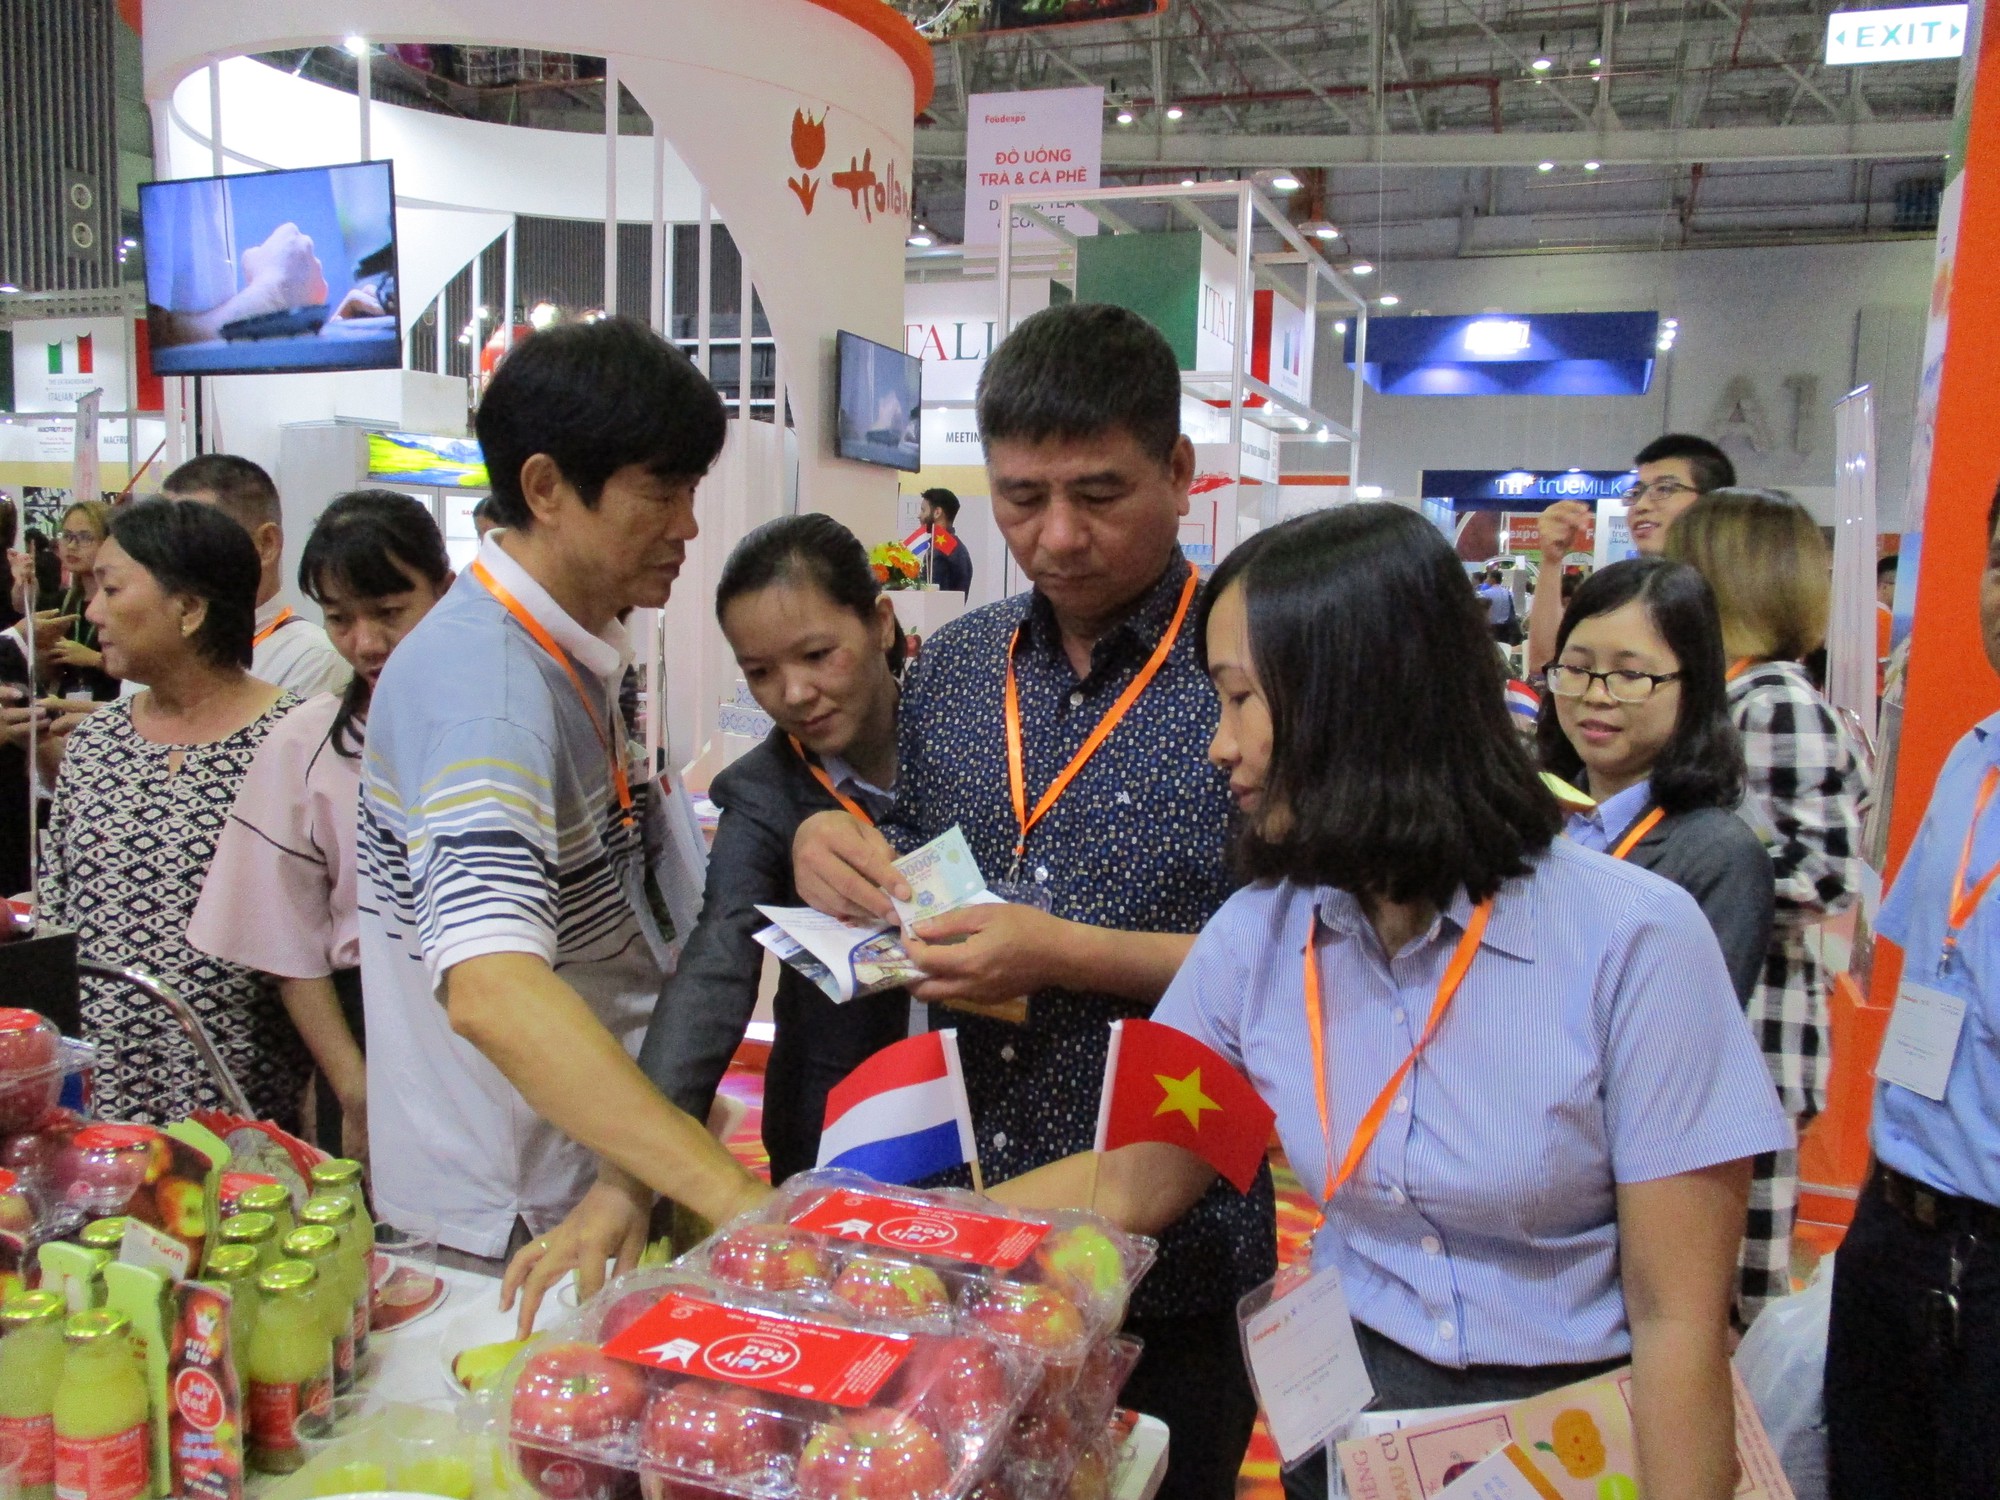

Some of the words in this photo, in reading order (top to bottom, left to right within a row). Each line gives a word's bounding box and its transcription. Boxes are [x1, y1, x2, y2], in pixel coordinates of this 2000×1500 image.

[1856, 21, 1942, 48] EXIT
[984, 114, 1026, 124] Foodexpo
[1023, 144, 1072, 164] UỐNG
[831, 147, 912, 224] Hollan
[1014, 171, 1025, 185] &
[103, 436, 128, 445] MACFRU
[945, 432, 981, 443] MEETIN
[1495, 479, 1524, 495] TH
[739, 1344, 791, 1364] Red
